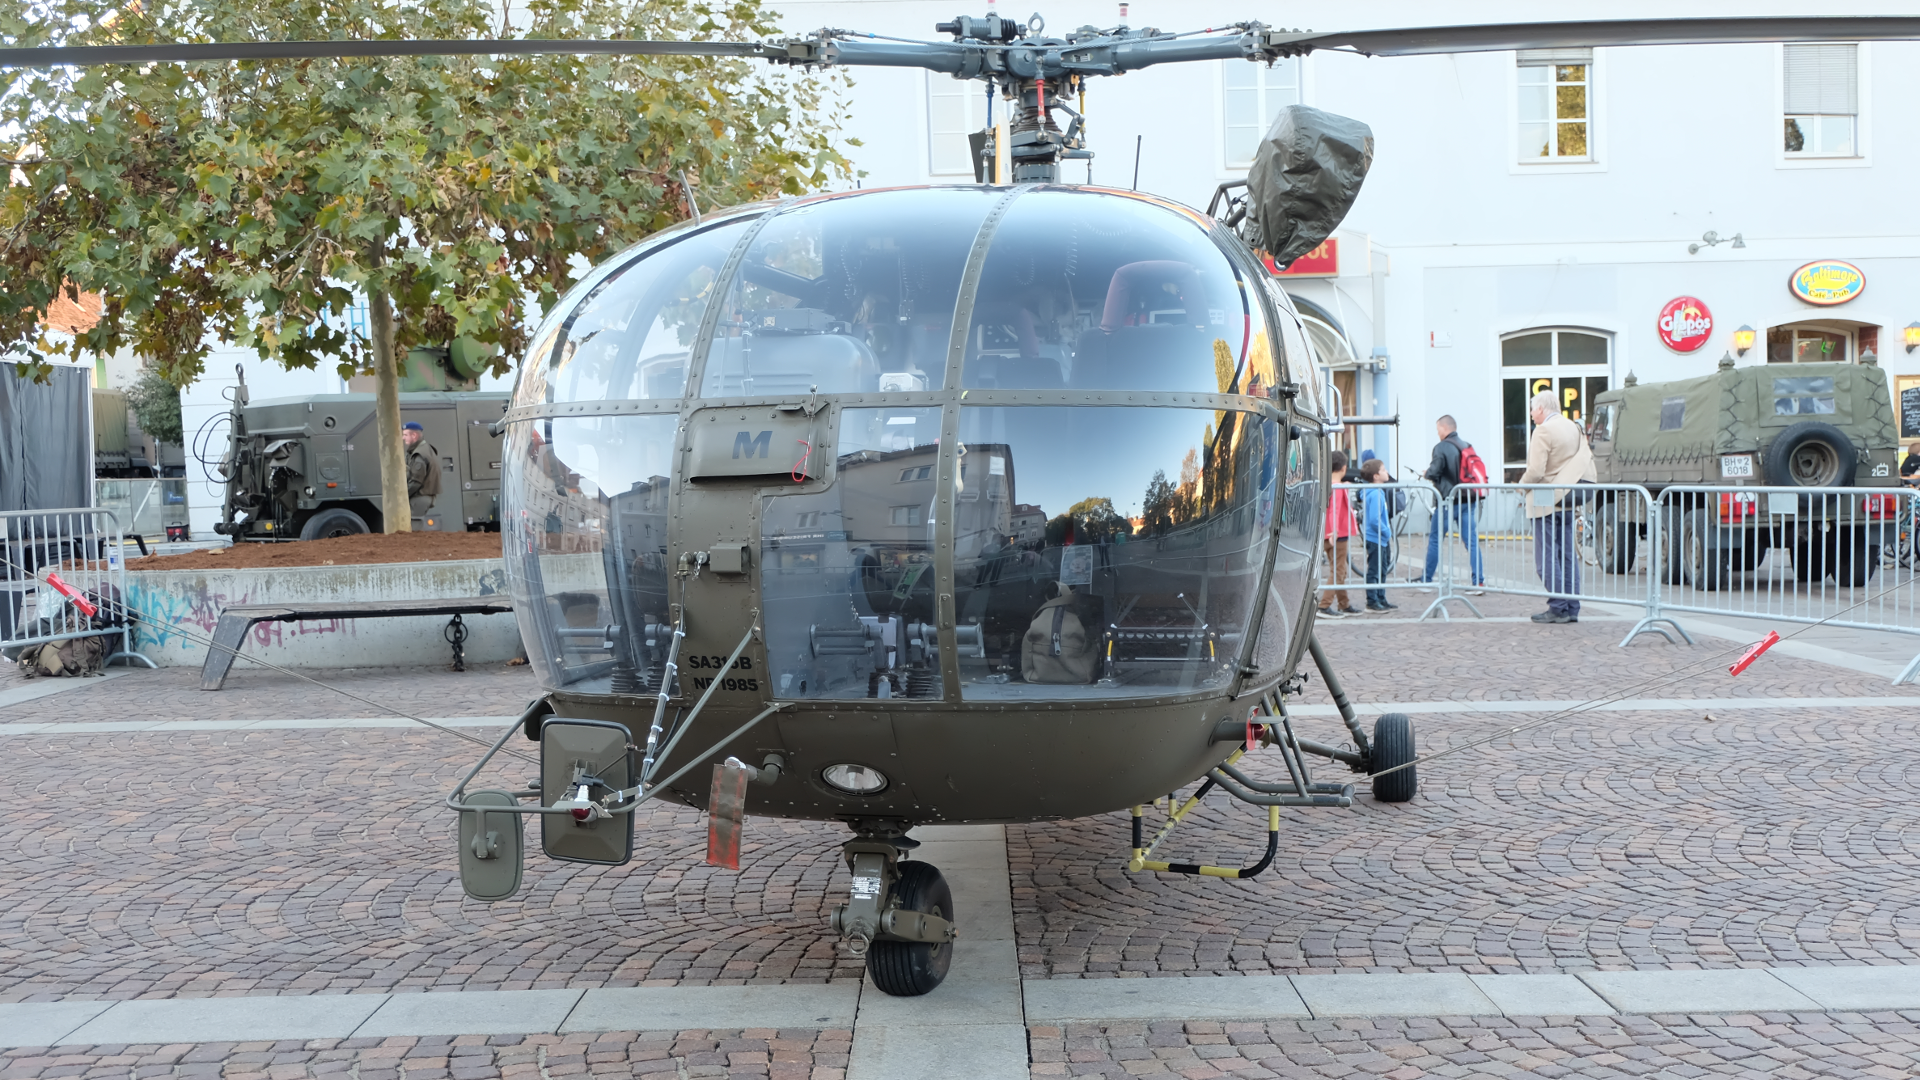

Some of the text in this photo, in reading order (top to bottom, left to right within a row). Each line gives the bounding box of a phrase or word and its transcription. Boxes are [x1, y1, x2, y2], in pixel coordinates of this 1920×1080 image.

[732, 430, 773, 459] M
[1724, 457, 1750, 466] BH 2
[1727, 466, 1748, 475] 6018
